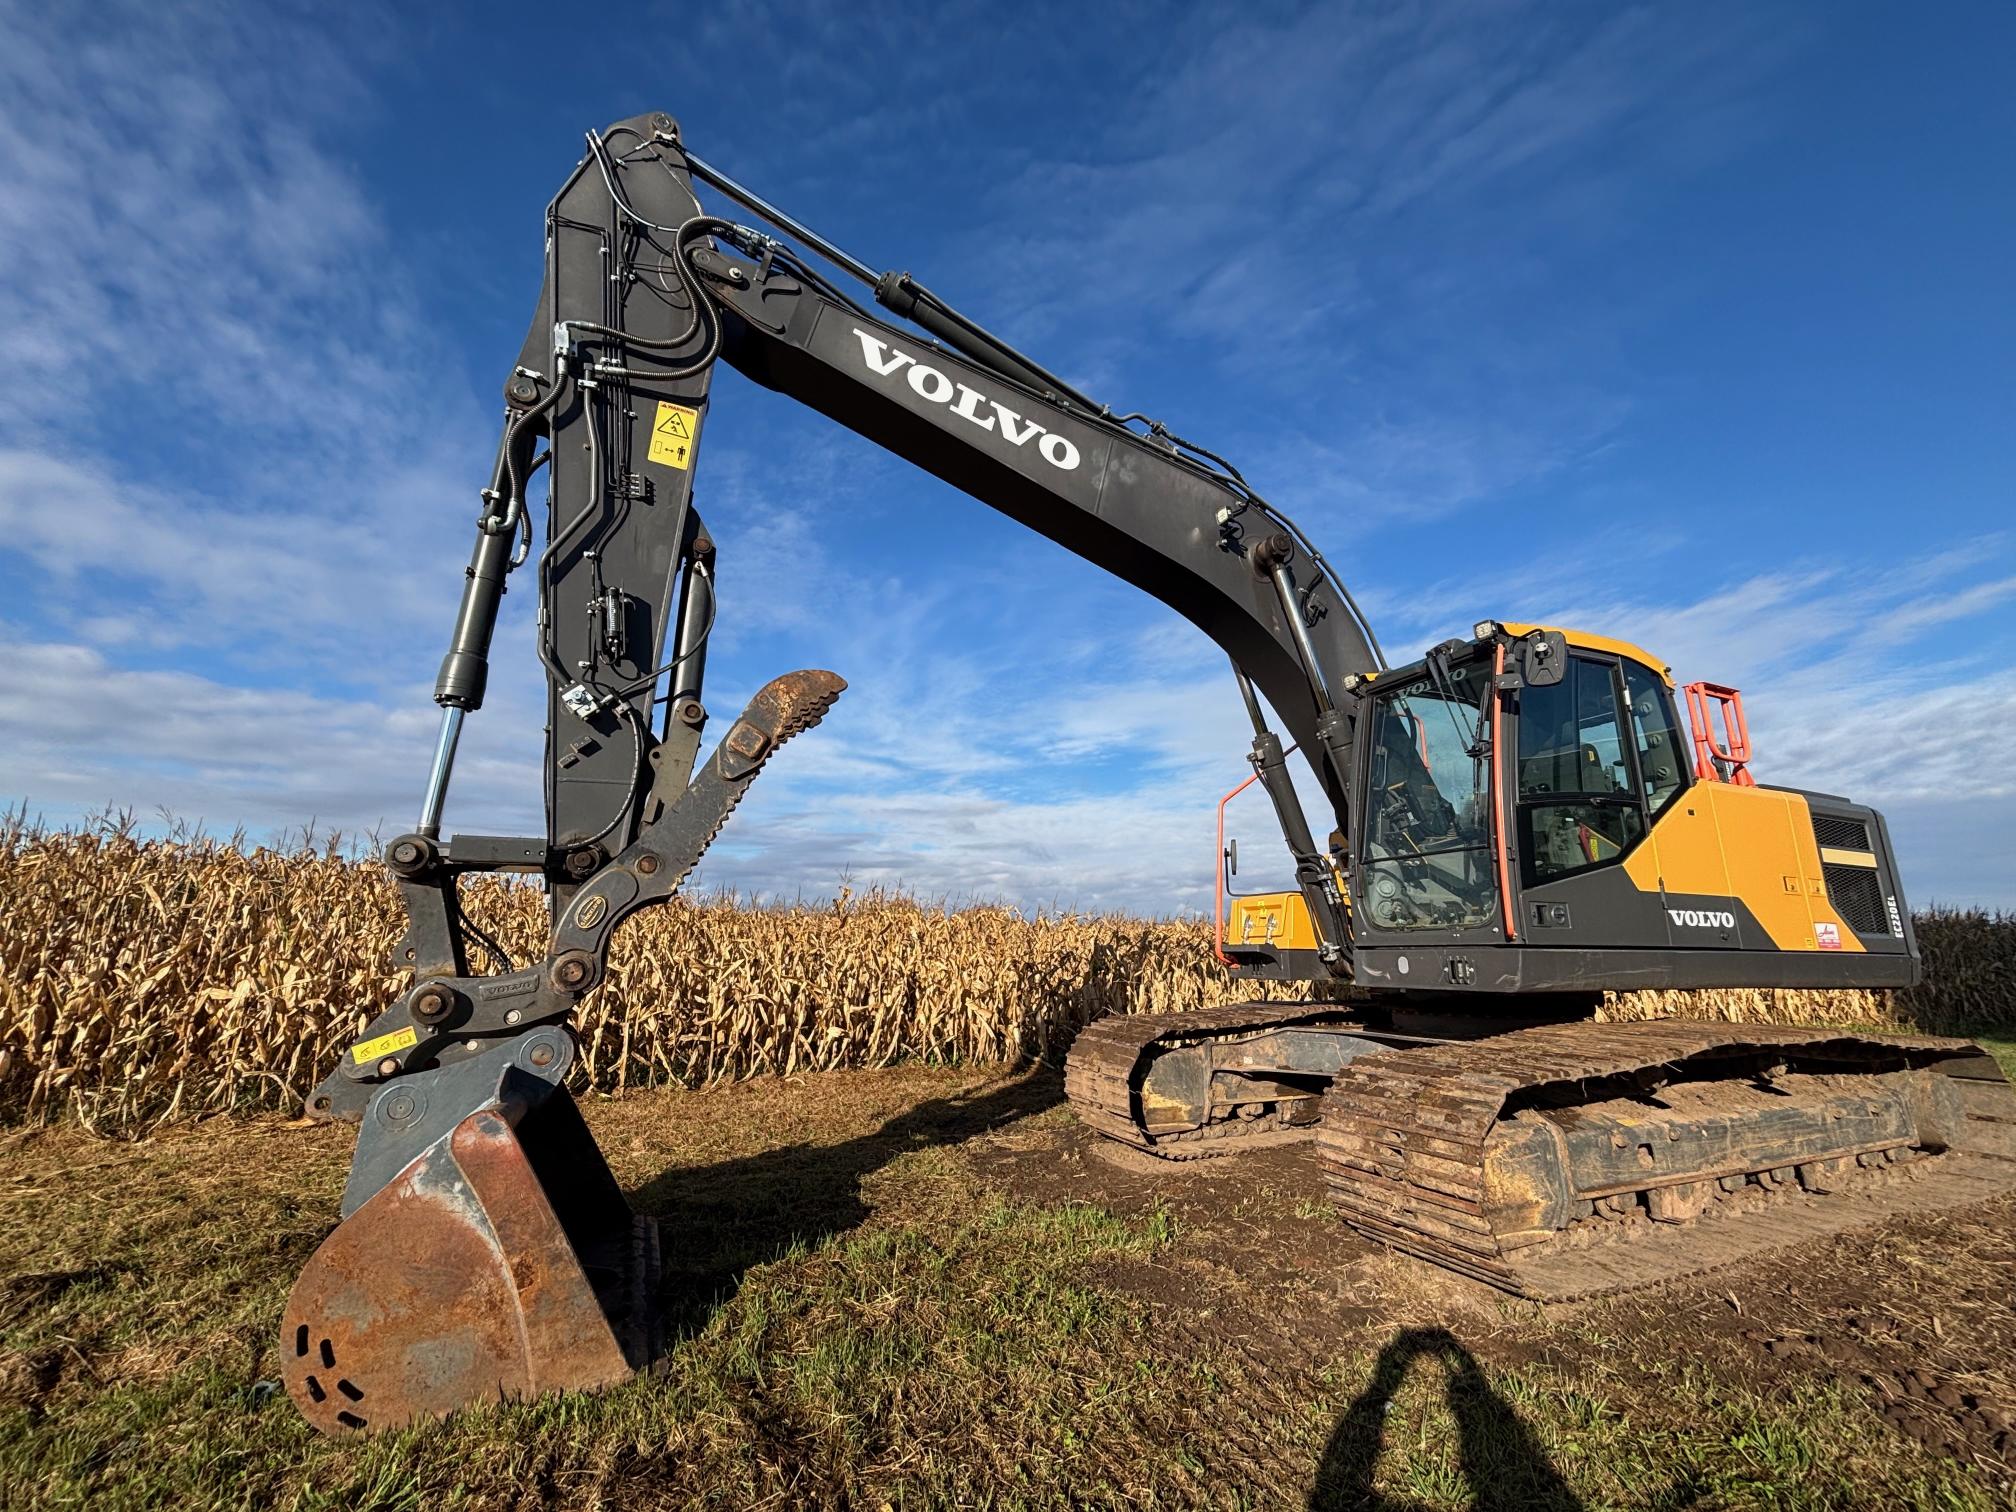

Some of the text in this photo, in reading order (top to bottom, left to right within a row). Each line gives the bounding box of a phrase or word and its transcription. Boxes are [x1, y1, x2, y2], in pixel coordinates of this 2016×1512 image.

[853, 328, 1080, 470] VOLVO
[1668, 909, 1735, 928] VOLVO
[1887, 895, 1904, 938] EC220EL
